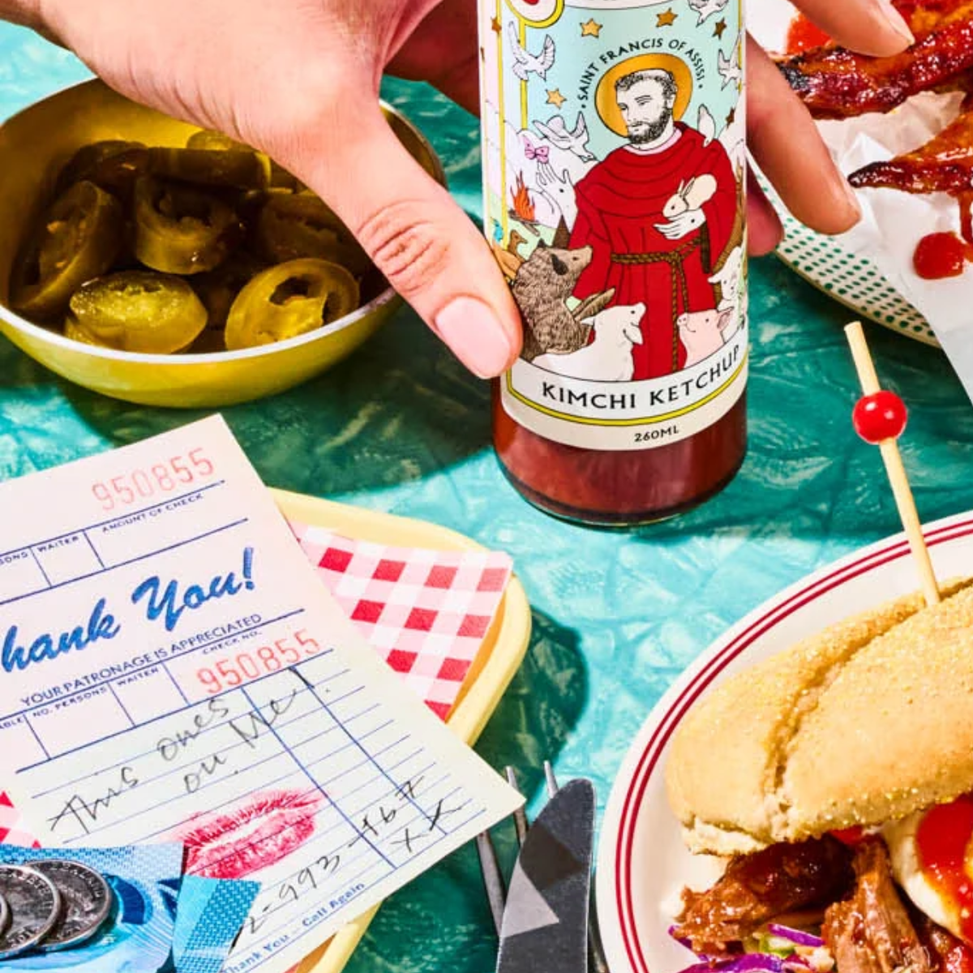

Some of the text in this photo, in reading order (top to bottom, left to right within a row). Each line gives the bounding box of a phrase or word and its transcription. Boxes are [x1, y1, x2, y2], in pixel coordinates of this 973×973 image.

[578, 37, 705, 101] SAINT FRANCIS OF ASSISI
[542, 344, 740, 410] KIMCHI KETCHUP
[634, 425, 680, 443] 260ML
[91, 447, 215, 512] 950855
[101, 492, 204, 534] AMOUNT OF CHECK
[37, 535, 80, 553] WAITER
[131, 546, 256, 632] You!
[20, 612, 263, 707] YOUR PATRONAGE IS APPRECIATED
[196, 627, 321, 694] 950855
[202, 637, 241, 655] CHECK
[54, 686, 108, 710] PERSONS
[117, 666, 160, 687] WAITER
[302, 905, 329, 928] Call
[329, 882, 366, 909] Again
